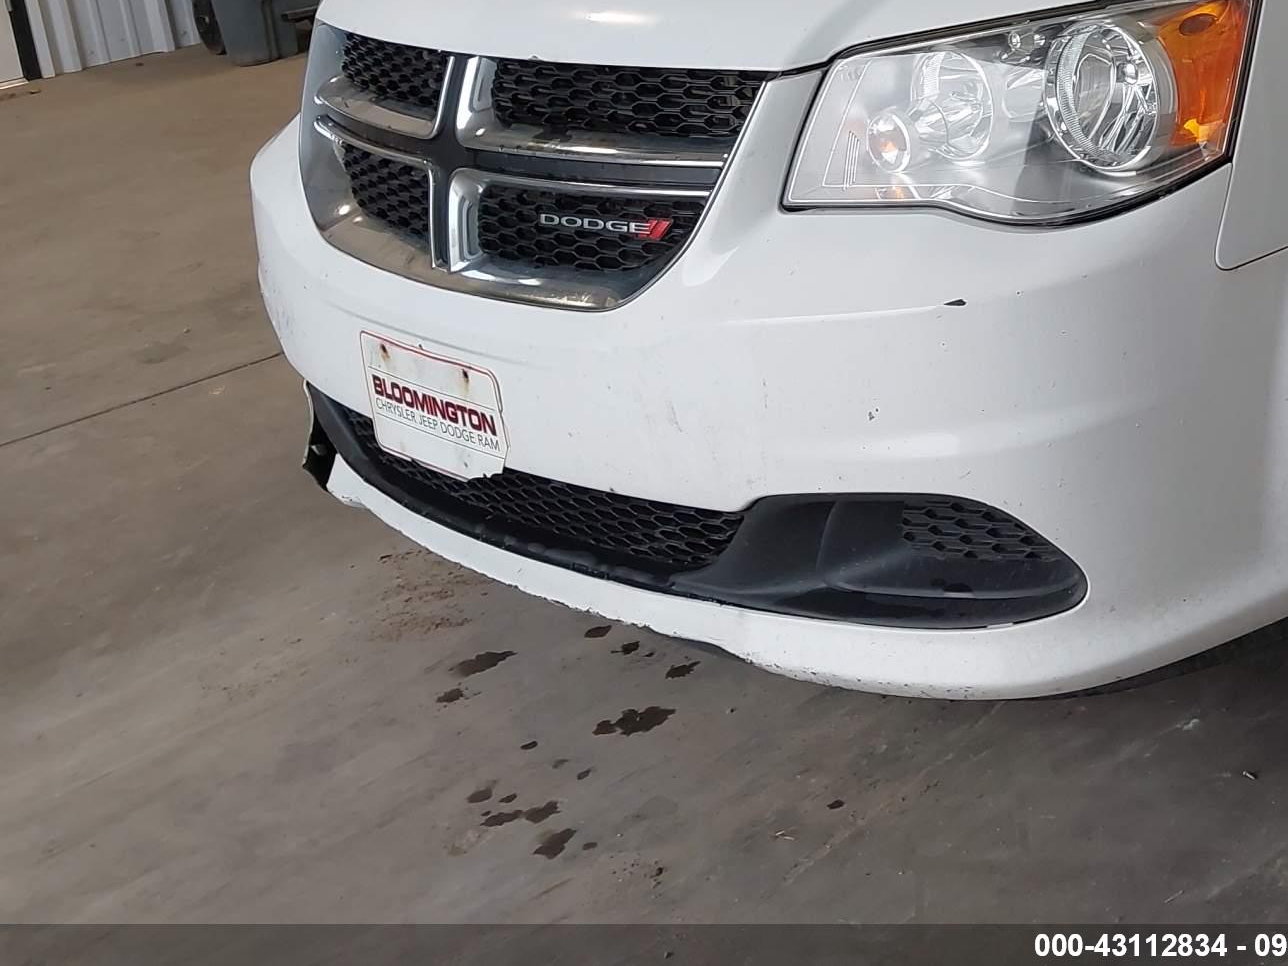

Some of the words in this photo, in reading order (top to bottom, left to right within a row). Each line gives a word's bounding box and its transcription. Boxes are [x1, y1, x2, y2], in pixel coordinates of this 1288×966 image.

[539, 213, 651, 235] DODGE
[372, 374, 497, 437] BLOOMINGTON
[375, 396, 417, 424] CHRYSLER
[418, 413, 438, 431] JEEP
[440, 421, 476, 445] DODGE
[478, 433, 501, 452] RAM
